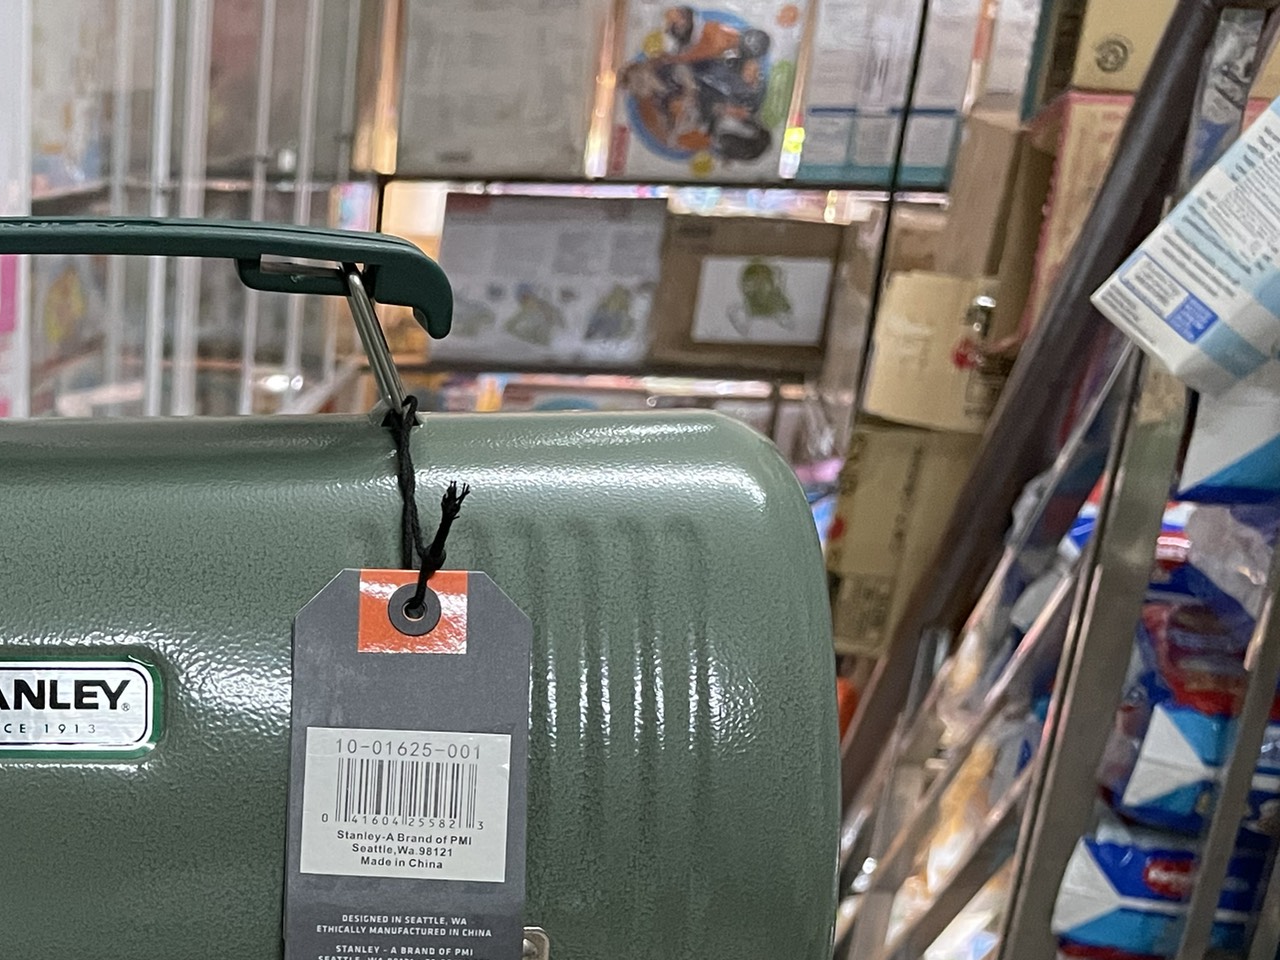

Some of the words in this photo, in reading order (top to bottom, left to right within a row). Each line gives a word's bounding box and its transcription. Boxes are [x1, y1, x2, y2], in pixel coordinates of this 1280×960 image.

[44, 723, 96, 734] 1913
[335, 738, 481, 760] 10-01625-001
[336, 829, 395, 843] Stanley-A
[397, 833, 432, 844] Brand
[435, 835, 448, 845] of
[450, 836, 473, 846] PMI
[360, 856, 392, 867] Made
[395, 857, 406, 867] in
[408, 858, 443, 870] China
[341, 914, 389, 924] DESIGNED
[391, 915, 402, 924] IN
[404, 916, 449, 926] SEATTLE,
[451, 917, 467, 926] WA
[316, 924, 367, 934] ETHICALLY
[369, 926, 447, 936] MANUFACTURED
[449, 928, 460, 937] IN
[462, 928, 492, 938] CHINA
[335, 944, 380, 955] STANLEY
[390, 946, 398, 955] A
[400, 946, 436, 956] BRAND
[438, 947, 452, 956] OF
[454, 948, 474, 957] PMI
